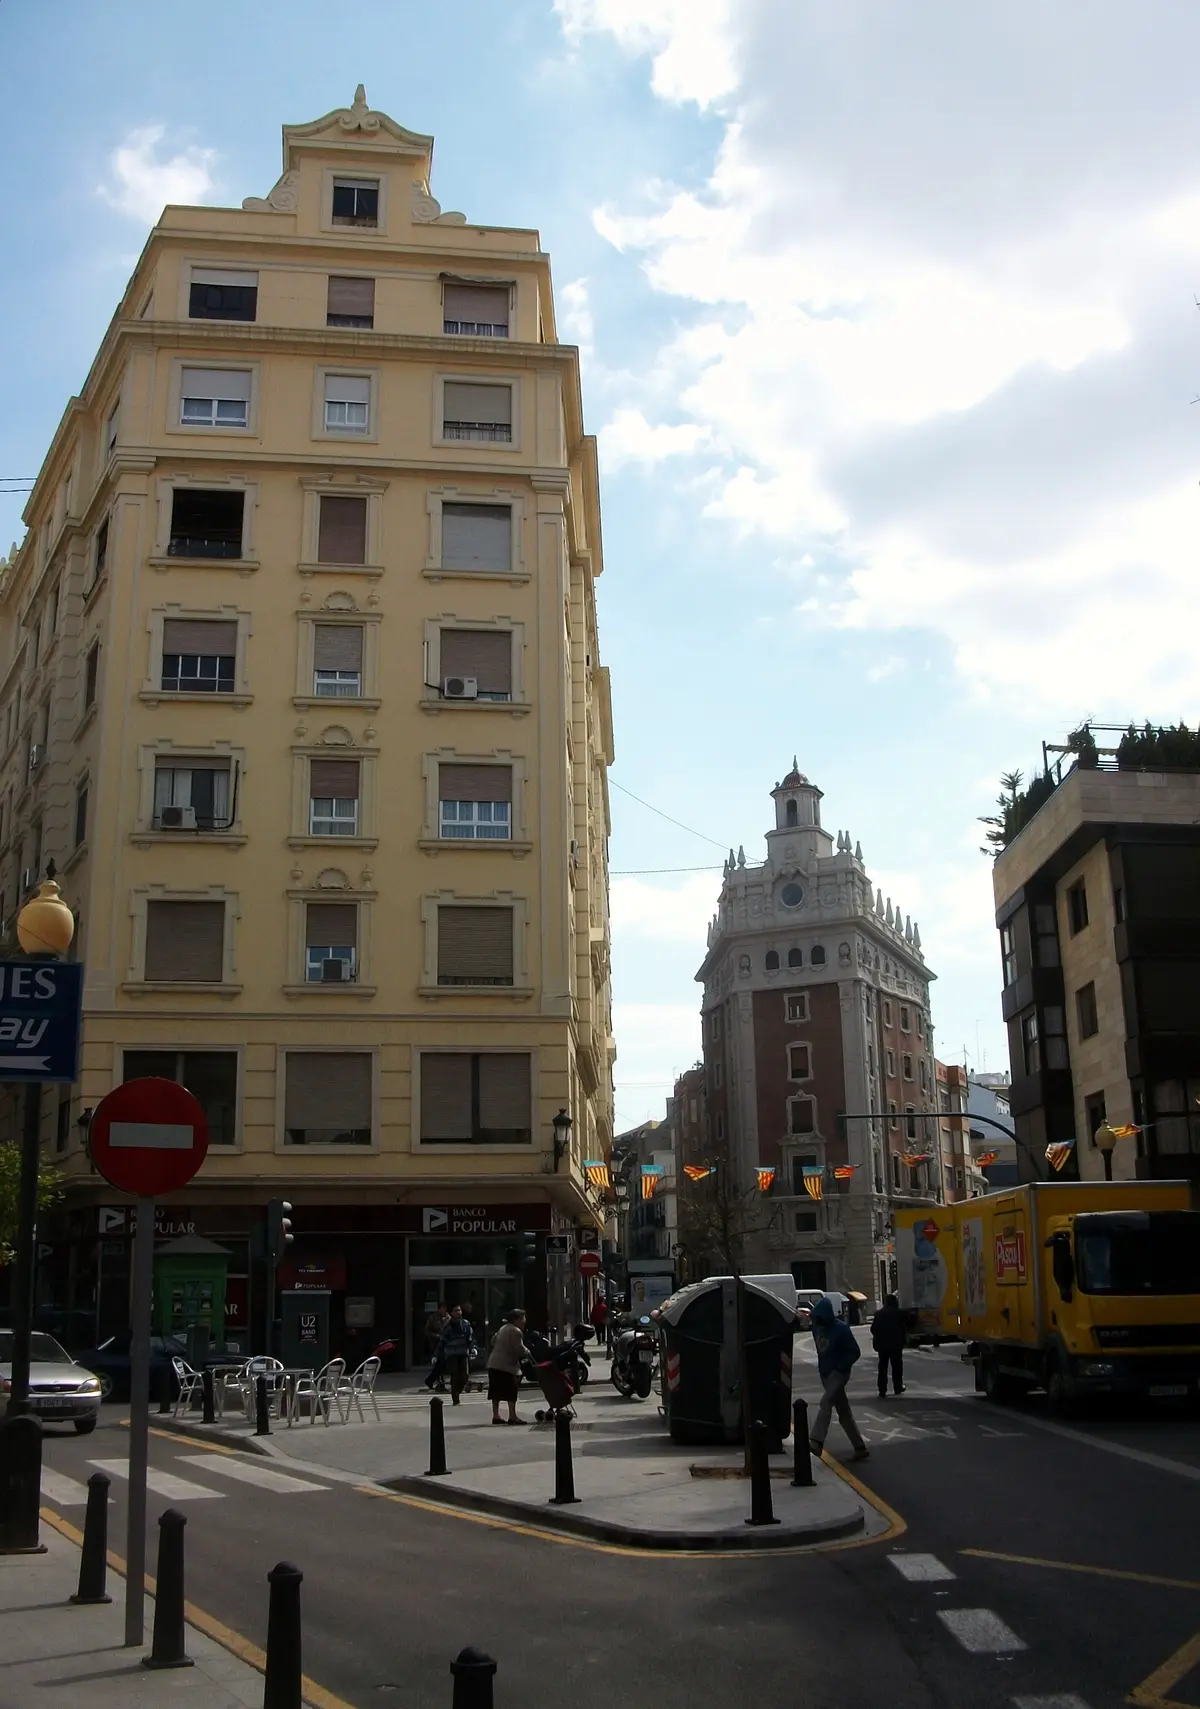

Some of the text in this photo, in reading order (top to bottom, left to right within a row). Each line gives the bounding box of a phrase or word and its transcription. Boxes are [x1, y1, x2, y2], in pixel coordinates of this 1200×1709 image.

[452, 1208, 486, 1216] BANCO
[130, 1222, 196, 1234] PPULAR
[453, 1220, 516, 1232] POPULAR
[301, 1315, 316, 1327] U2
